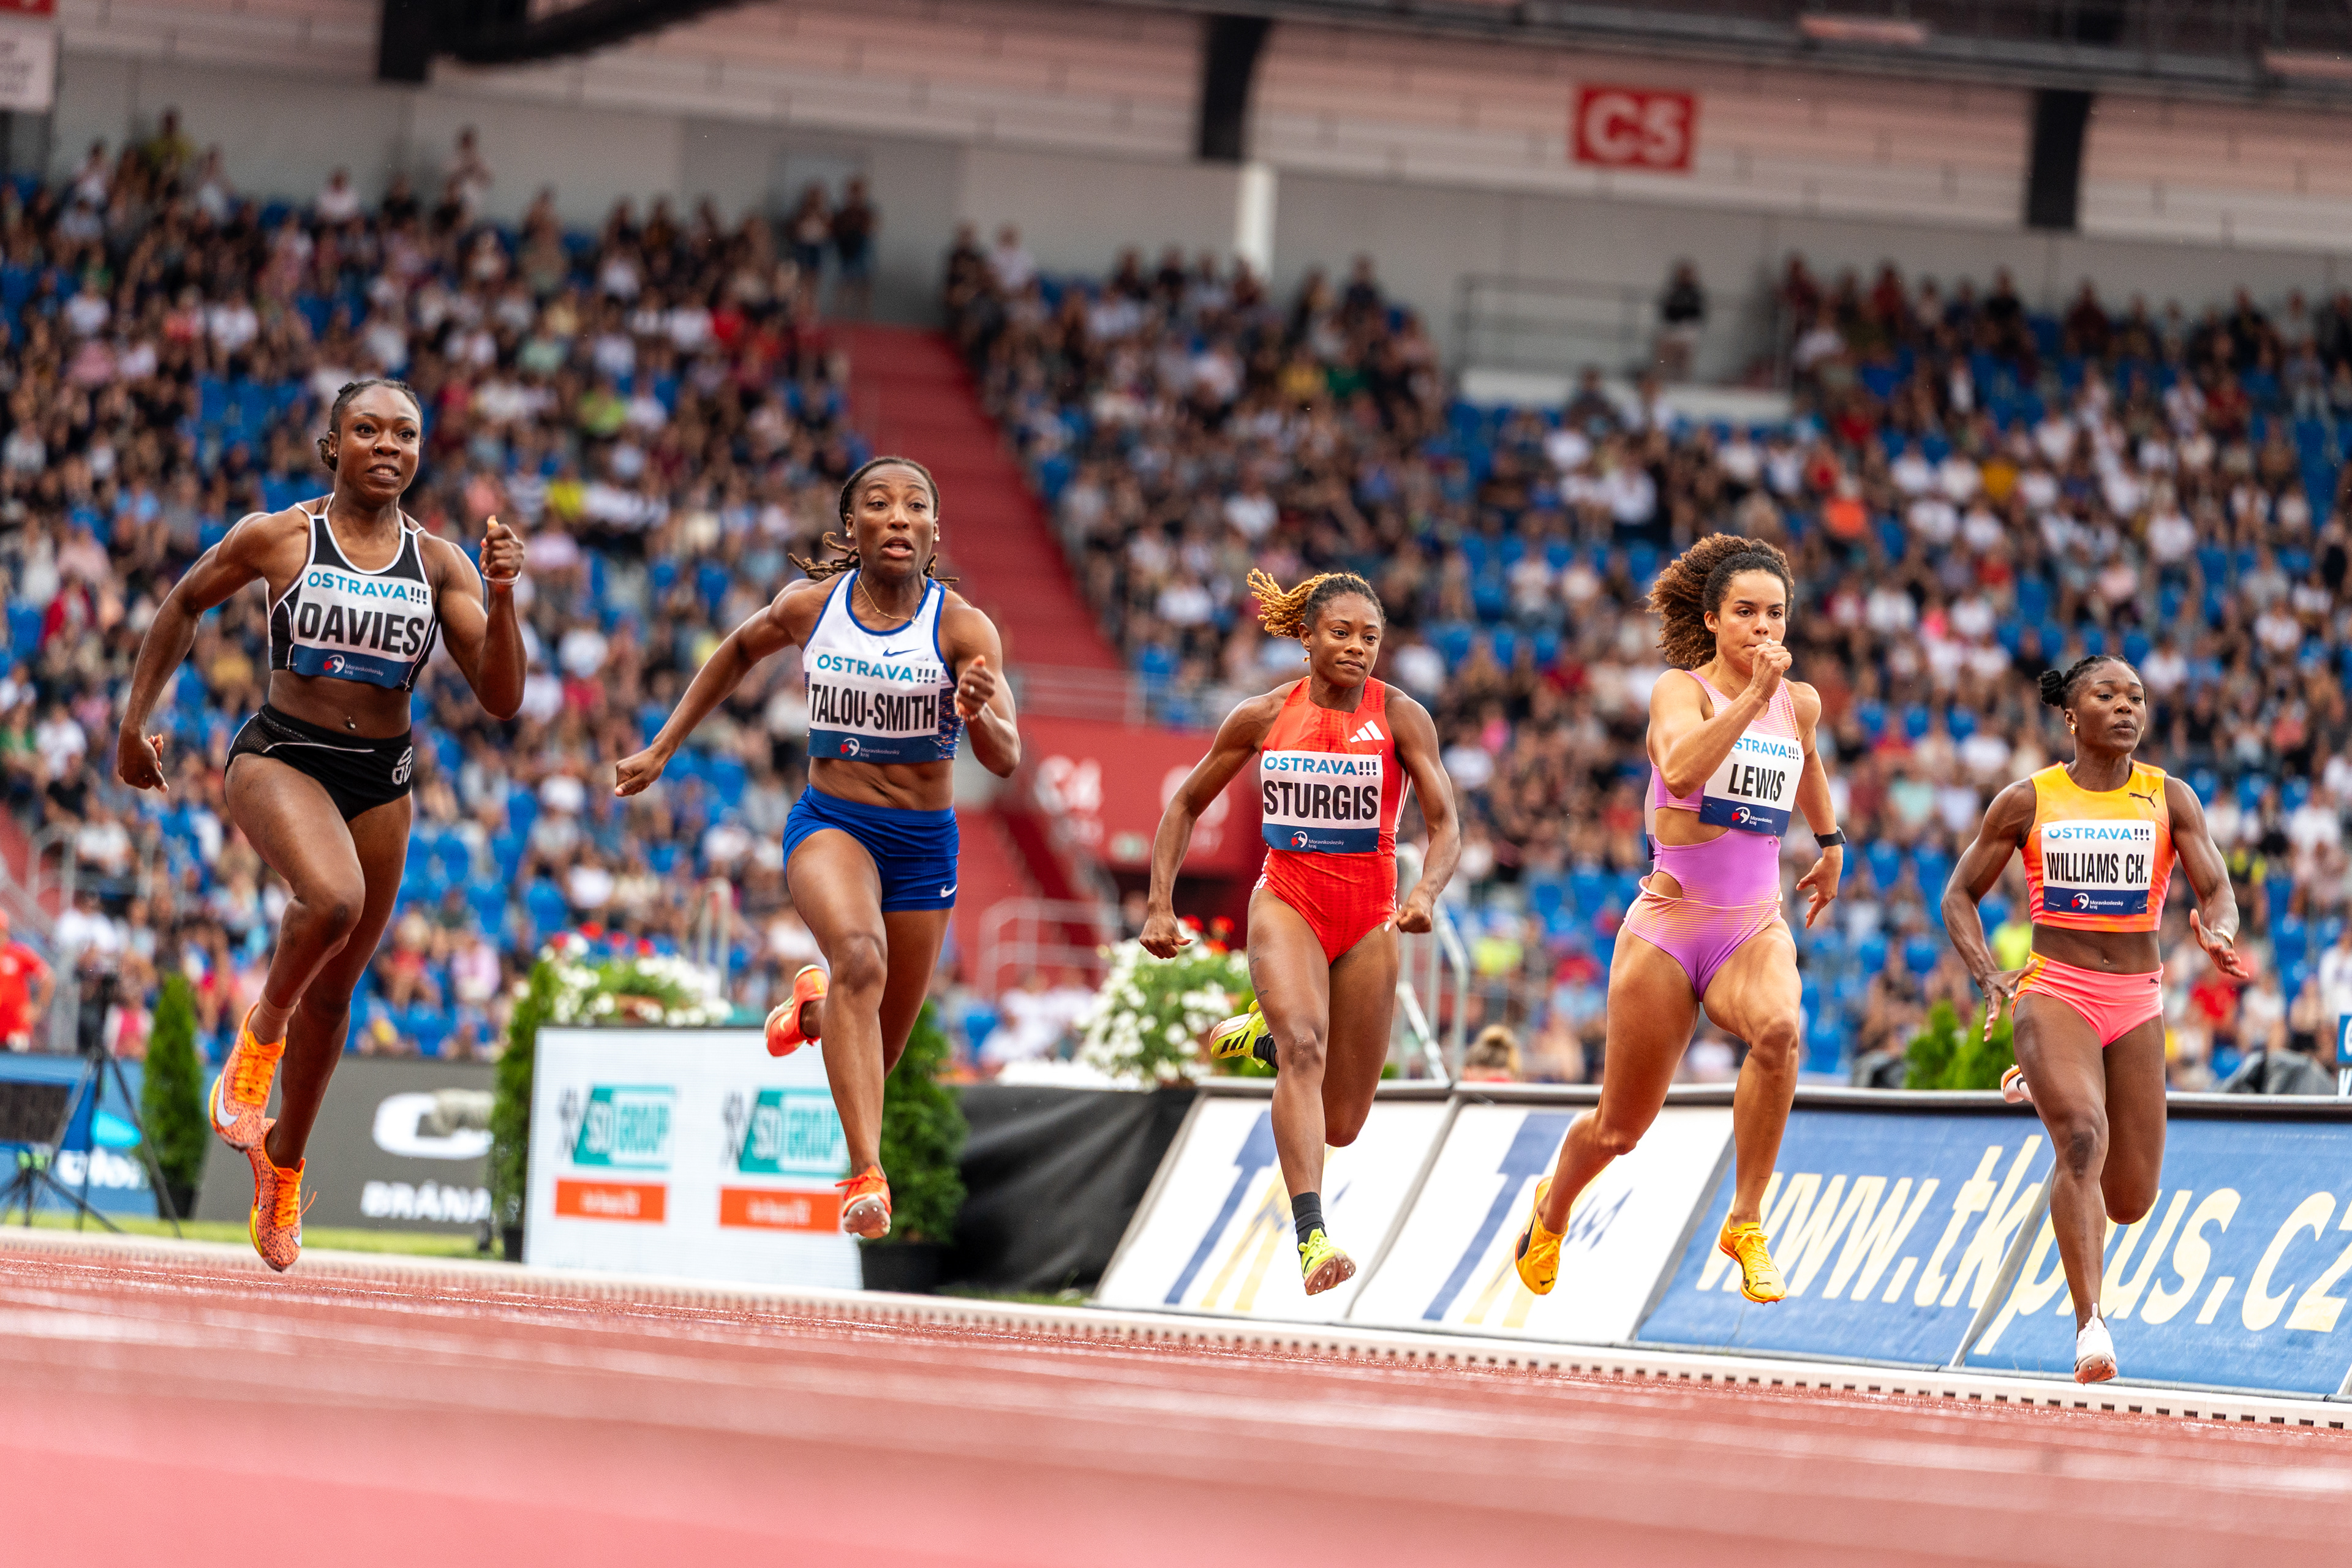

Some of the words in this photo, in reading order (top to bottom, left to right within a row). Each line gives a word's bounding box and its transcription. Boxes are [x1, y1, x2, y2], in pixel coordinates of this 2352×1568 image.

[298, 601, 425, 657] DAVIES
[812, 684, 937, 732] TALOU-SMITH
[1734, 737, 1799, 760] STRAVA!!!
[1263, 780, 1378, 820] STURGIS
[1727, 763, 1785, 802] LEWIS
[2046, 852, 2119, 884] WILLIAMS
[2125, 853, 2147, 884] CH.
